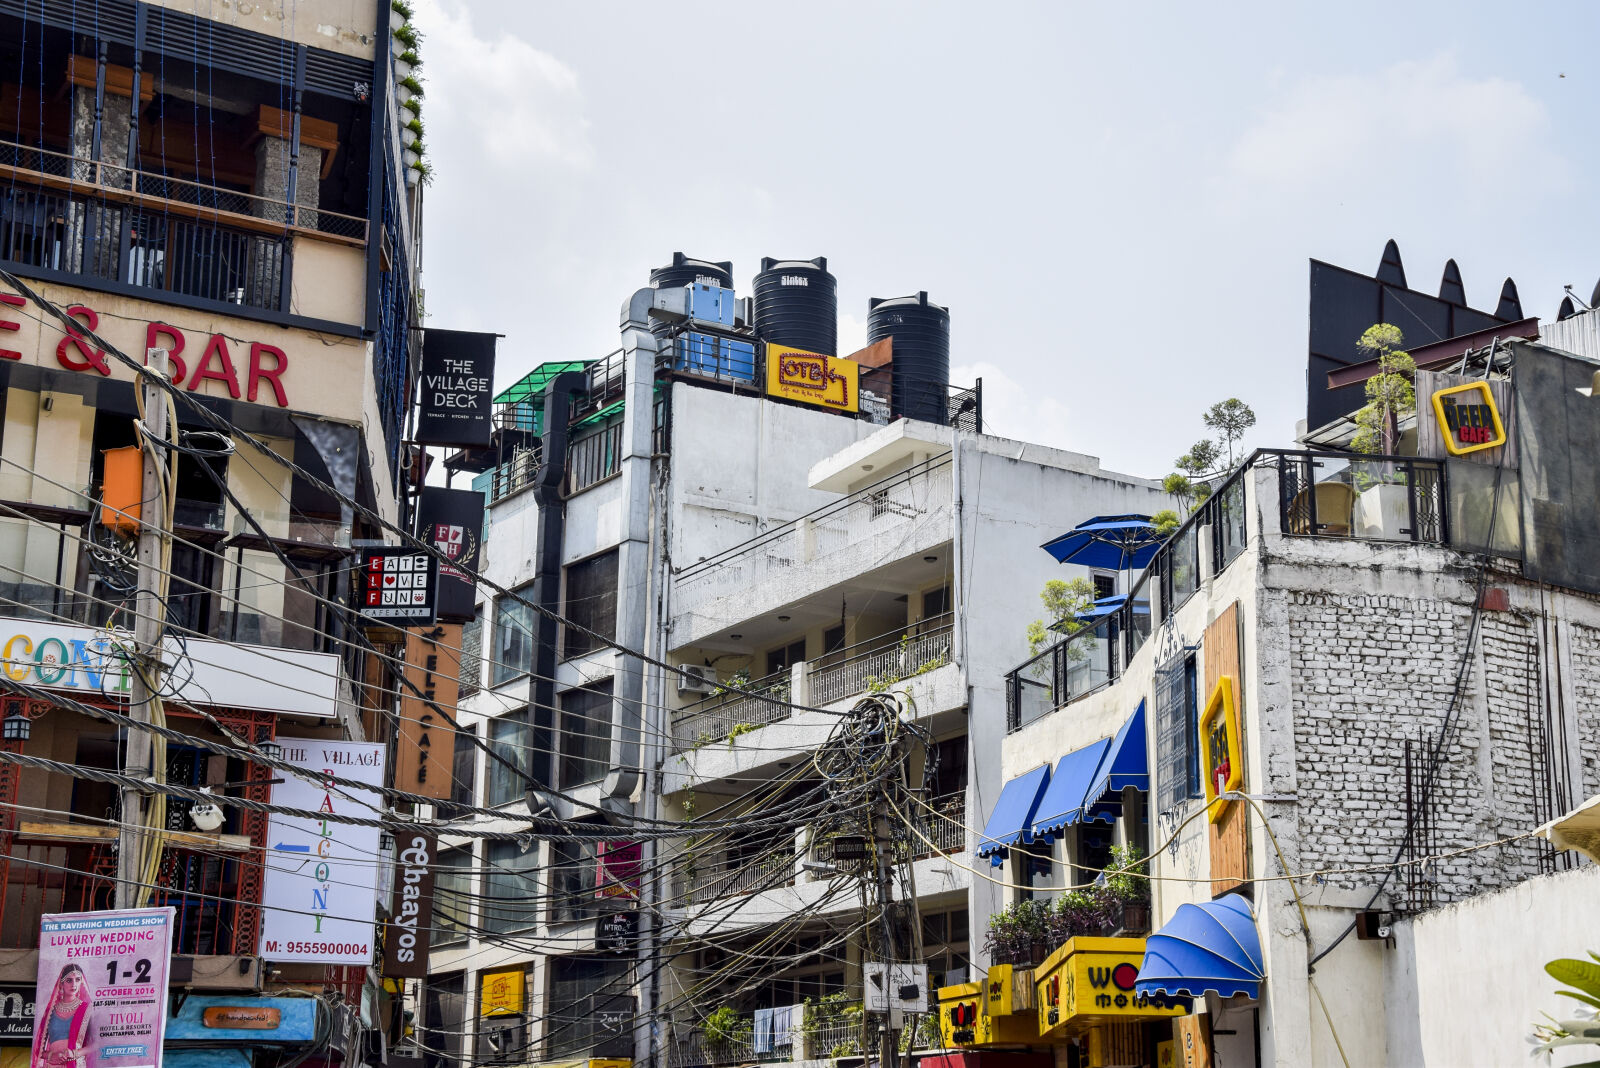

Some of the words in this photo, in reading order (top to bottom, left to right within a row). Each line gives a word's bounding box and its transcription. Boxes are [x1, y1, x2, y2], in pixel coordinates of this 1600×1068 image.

[781, 275, 809, 287] Sintex
[55, 305, 112, 377] &
[143, 321, 289, 408] BAR
[443, 359, 474, 375] THE
[784, 359, 824, 381] OTB
[426, 375, 489, 393] VILLAGE
[434, 392, 478, 409] DECK
[1443, 404, 1495, 432] BEER
[372, 558, 410, 570] EAT
[369, 592, 408, 604] FUN
[364, 609, 390, 617] CAFE
[282, 748, 308, 762] THE
[322, 750, 381, 767] VILLAGE
[311, 768, 337, 934] BALCONY
[394, 836, 430, 963] Chaayos
[44, 923, 60, 932] THE
[60, 920, 103, 931] RAVISHING
[104, 918, 140, 928] WEDDING
[141, 917, 164, 926] SHOW
[50, 933, 96, 947] LUXURY
[99, 930, 155, 944] WEDDING
[66, 943, 136, 958] EXHIBITION
[265, 941, 283, 953] M:
[286, 941, 368, 955] 9555900004
[106, 958, 152, 985] 1-2
[95, 988, 133, 998] OCTOBER
[135, 987, 155, 996] 2016
[93, 1000, 116, 1008] SAT-SUN
[109, 1011, 144, 1025] TIVOLI
[3, 1022, 32, 1033] Made
[125, 1023, 152, 1031] RESORTS
[105, 1047, 127, 1056] ENTRY
[127, 1046, 144, 1055] FREE
